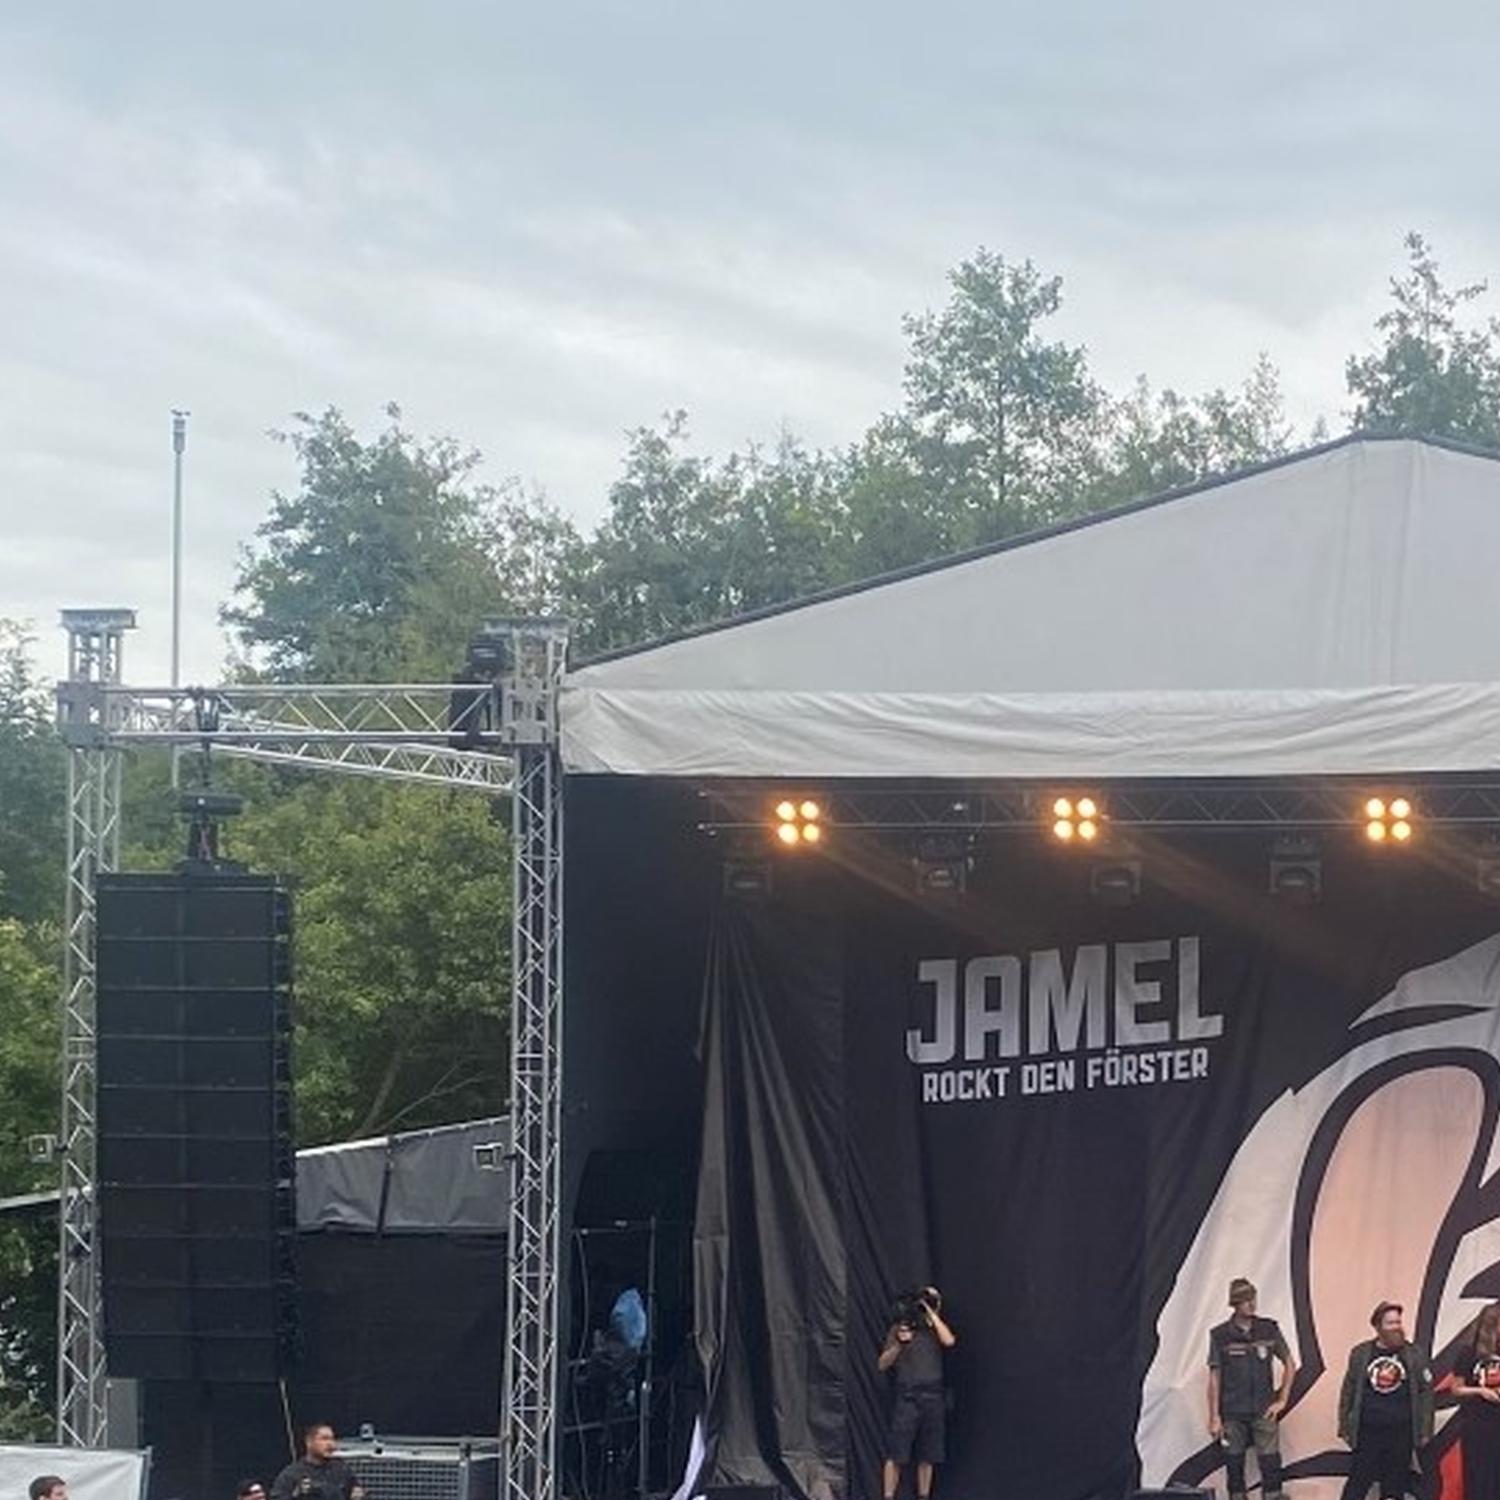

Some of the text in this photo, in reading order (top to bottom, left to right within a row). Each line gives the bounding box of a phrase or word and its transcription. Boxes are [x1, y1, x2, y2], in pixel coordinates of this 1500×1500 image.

[906, 936, 1223, 1064] JAMEL
[923, 1047, 1208, 1102] ROCKT DEN FÖRSTER
